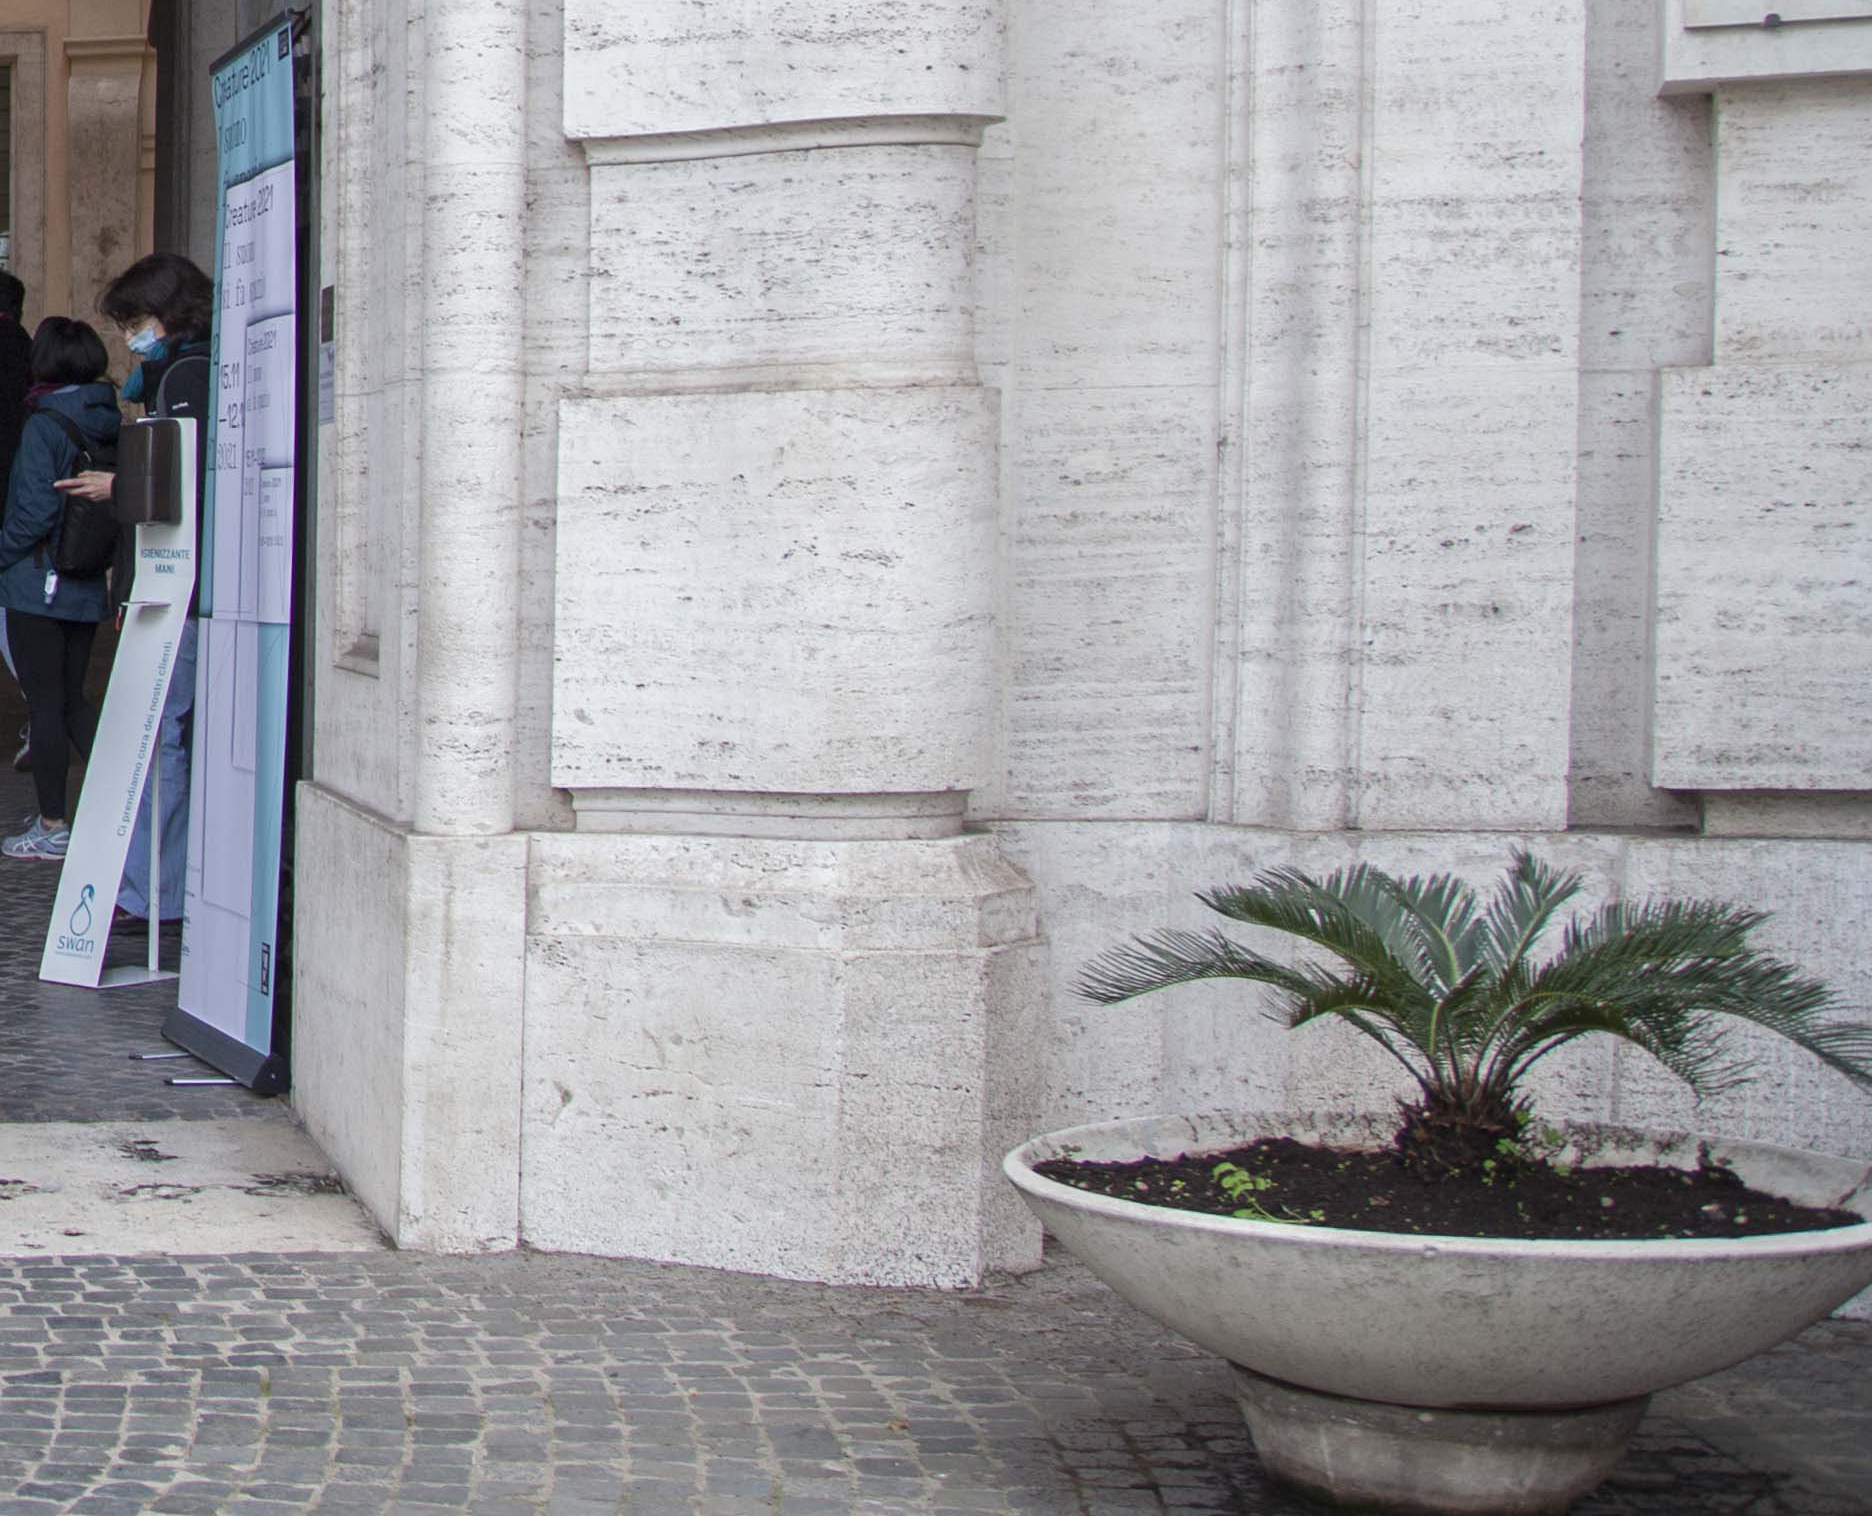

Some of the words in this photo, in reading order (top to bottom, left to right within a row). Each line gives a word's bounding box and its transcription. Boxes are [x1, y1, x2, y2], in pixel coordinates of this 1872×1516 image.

[140, 548, 191, 560] IGIENIZZANTE
[155, 563, 175, 574] MANI
[157, 641, 173, 676] clienti
[150, 679, 163, 711] nostri
[143, 714, 155, 731] dei
[138, 734, 149, 760] cura
[122, 761, 143, 823] prendiamo
[117, 825, 126, 837] Ci
[57, 935, 95, 954] swan
